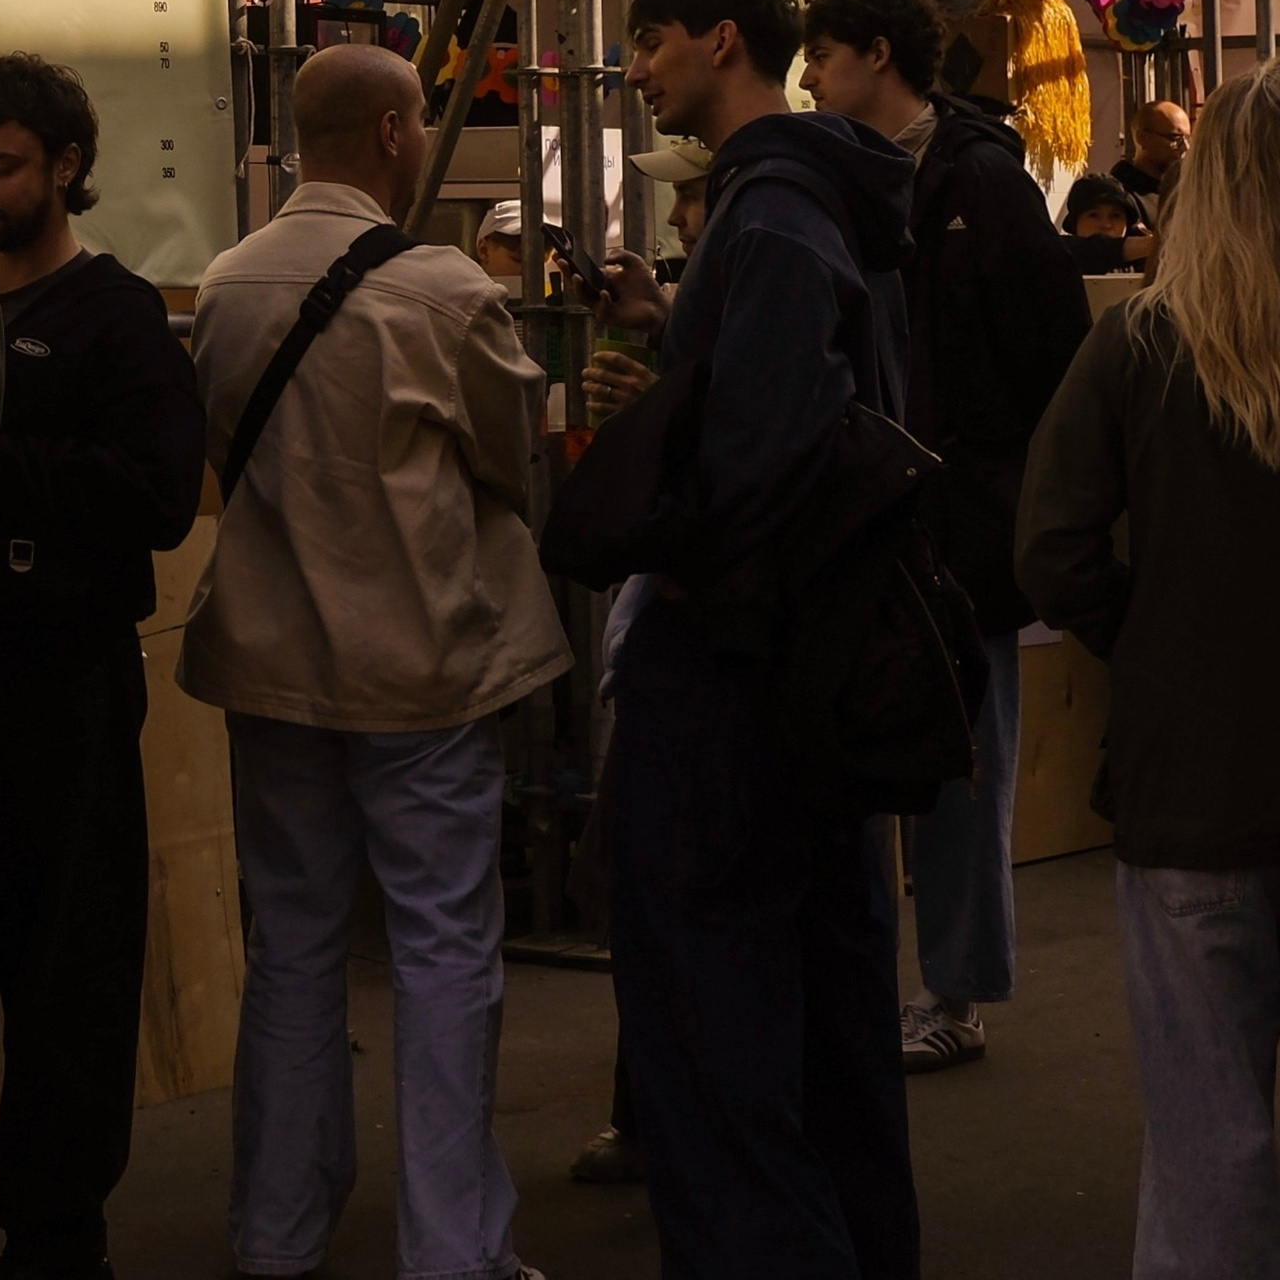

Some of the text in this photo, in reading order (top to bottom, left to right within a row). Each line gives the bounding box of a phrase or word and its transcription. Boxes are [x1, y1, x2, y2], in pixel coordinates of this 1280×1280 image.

[154, 1, 167, 12] 890
[160, 42, 169, 53] 50
[160, 58, 169, 69] 70
[161, 140, 174, 151] 300
[162, 168, 175, 179] 350
